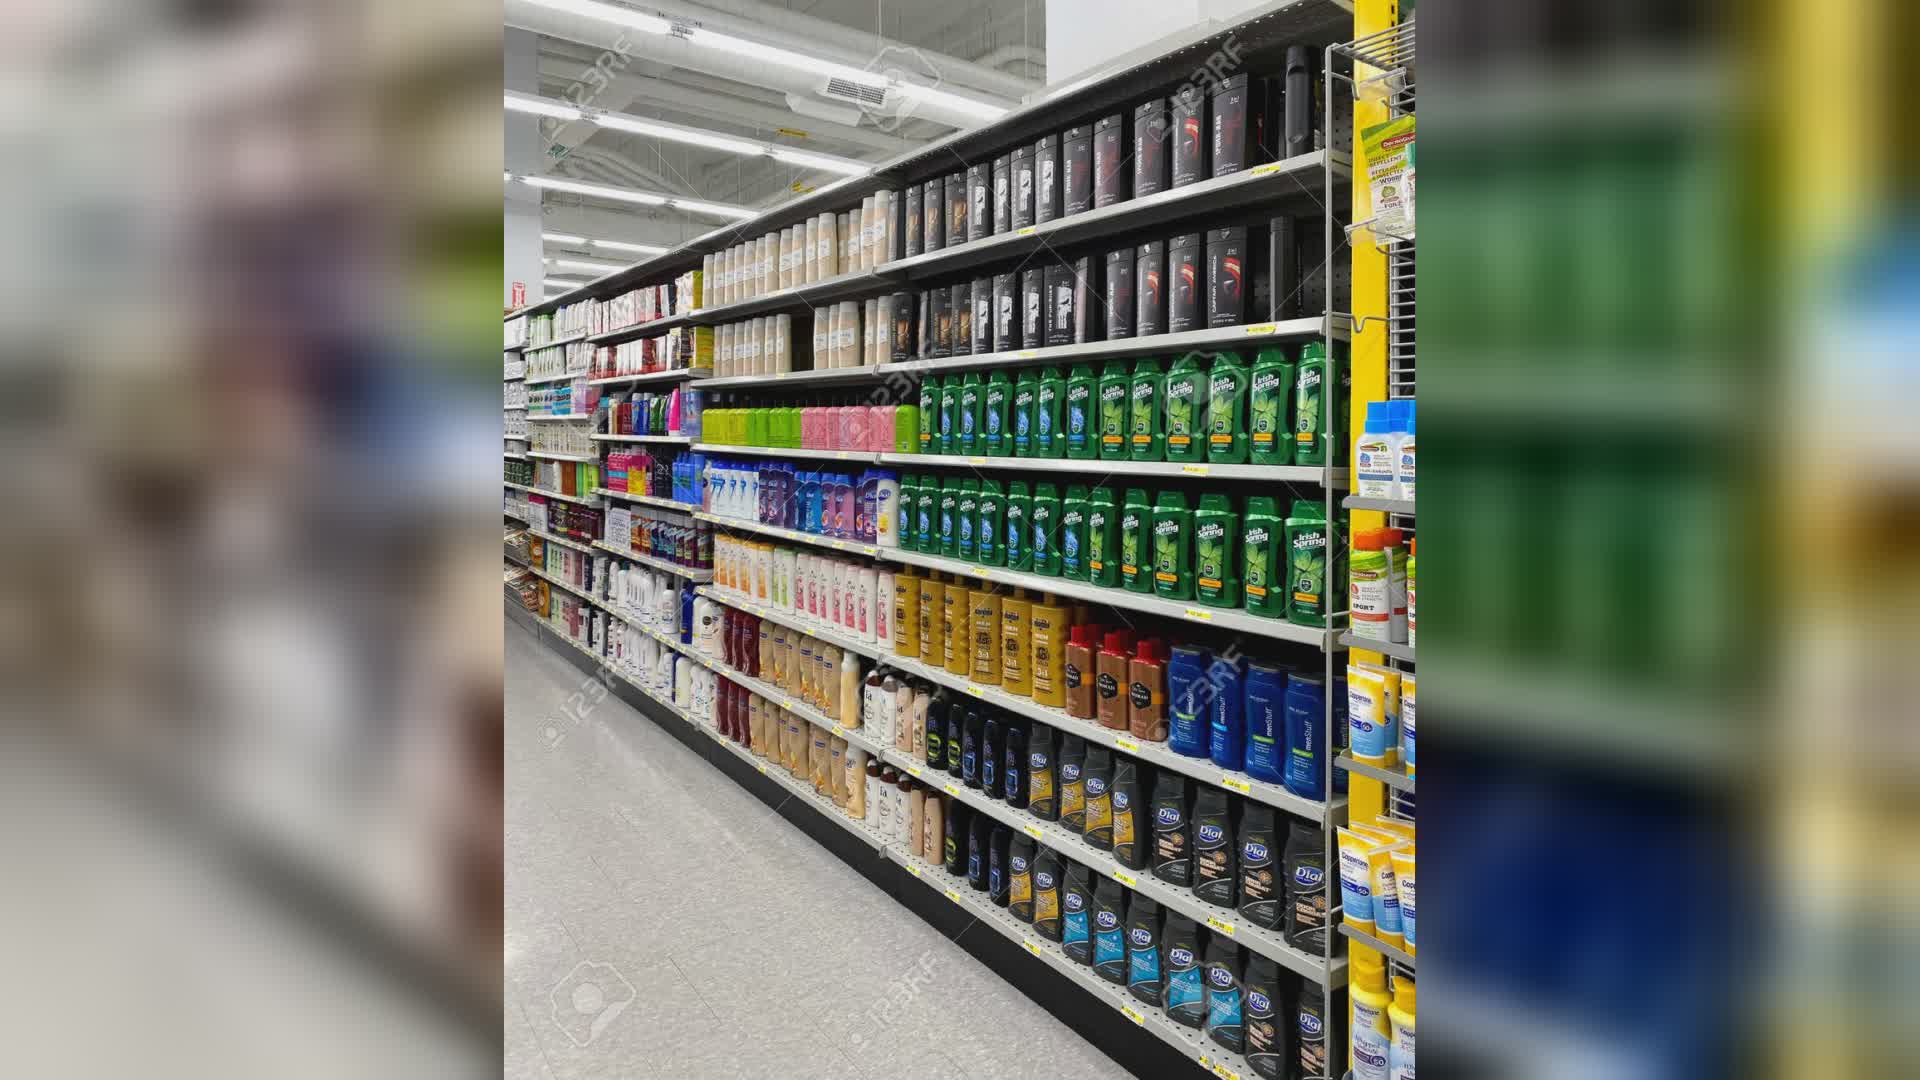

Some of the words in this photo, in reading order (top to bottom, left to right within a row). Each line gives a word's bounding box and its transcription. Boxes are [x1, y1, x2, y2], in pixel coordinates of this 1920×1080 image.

[1253, 378, 1280, 392] Spring
[1257, 374, 1274, 384] Irish
[1106, 385, 1119, 394] Irish
[1168, 385, 1193, 398] Spring
[1173, 381, 1188, 390] Irish
[1102, 388, 1124, 400] Spring
[1133, 386, 1152, 399] Spring
[1155, 524, 1178, 535] Spring
[1158, 520, 1174, 528] Irish
[1198, 528, 1223, 538] Spring
[1245, 532, 1268, 543] Spring
[1294, 537, 1326, 549] Spring
[1353, 603, 1375, 611] SPORT
[1350, 691, 1372, 705] Coppertone
[1032, 754, 1046, 764] Dial
[1063, 764, 1079, 776] Dial
[1088, 778, 1104, 790] Dial
[1114, 792, 1128, 804] Dial
[1159, 808, 1180, 821] Dial
[1200, 826, 1222, 839] Dial
[1245, 844, 1268, 858] Dial
[1342, 852, 1369, 867] Coppertone
[1038, 873, 1052, 884] Dial
[1296, 867, 1322, 881] Dial
[1067, 893, 1082, 906] Dial
[1098, 912, 1116, 924] Dial
[1132, 929, 1151, 942] Dial
[1171, 949, 1192, 962] Dial
[1212, 968, 1232, 983] Dial
[1250, 992, 1270, 1008] Dial
[1300, 1013, 1321, 1031] Dial
